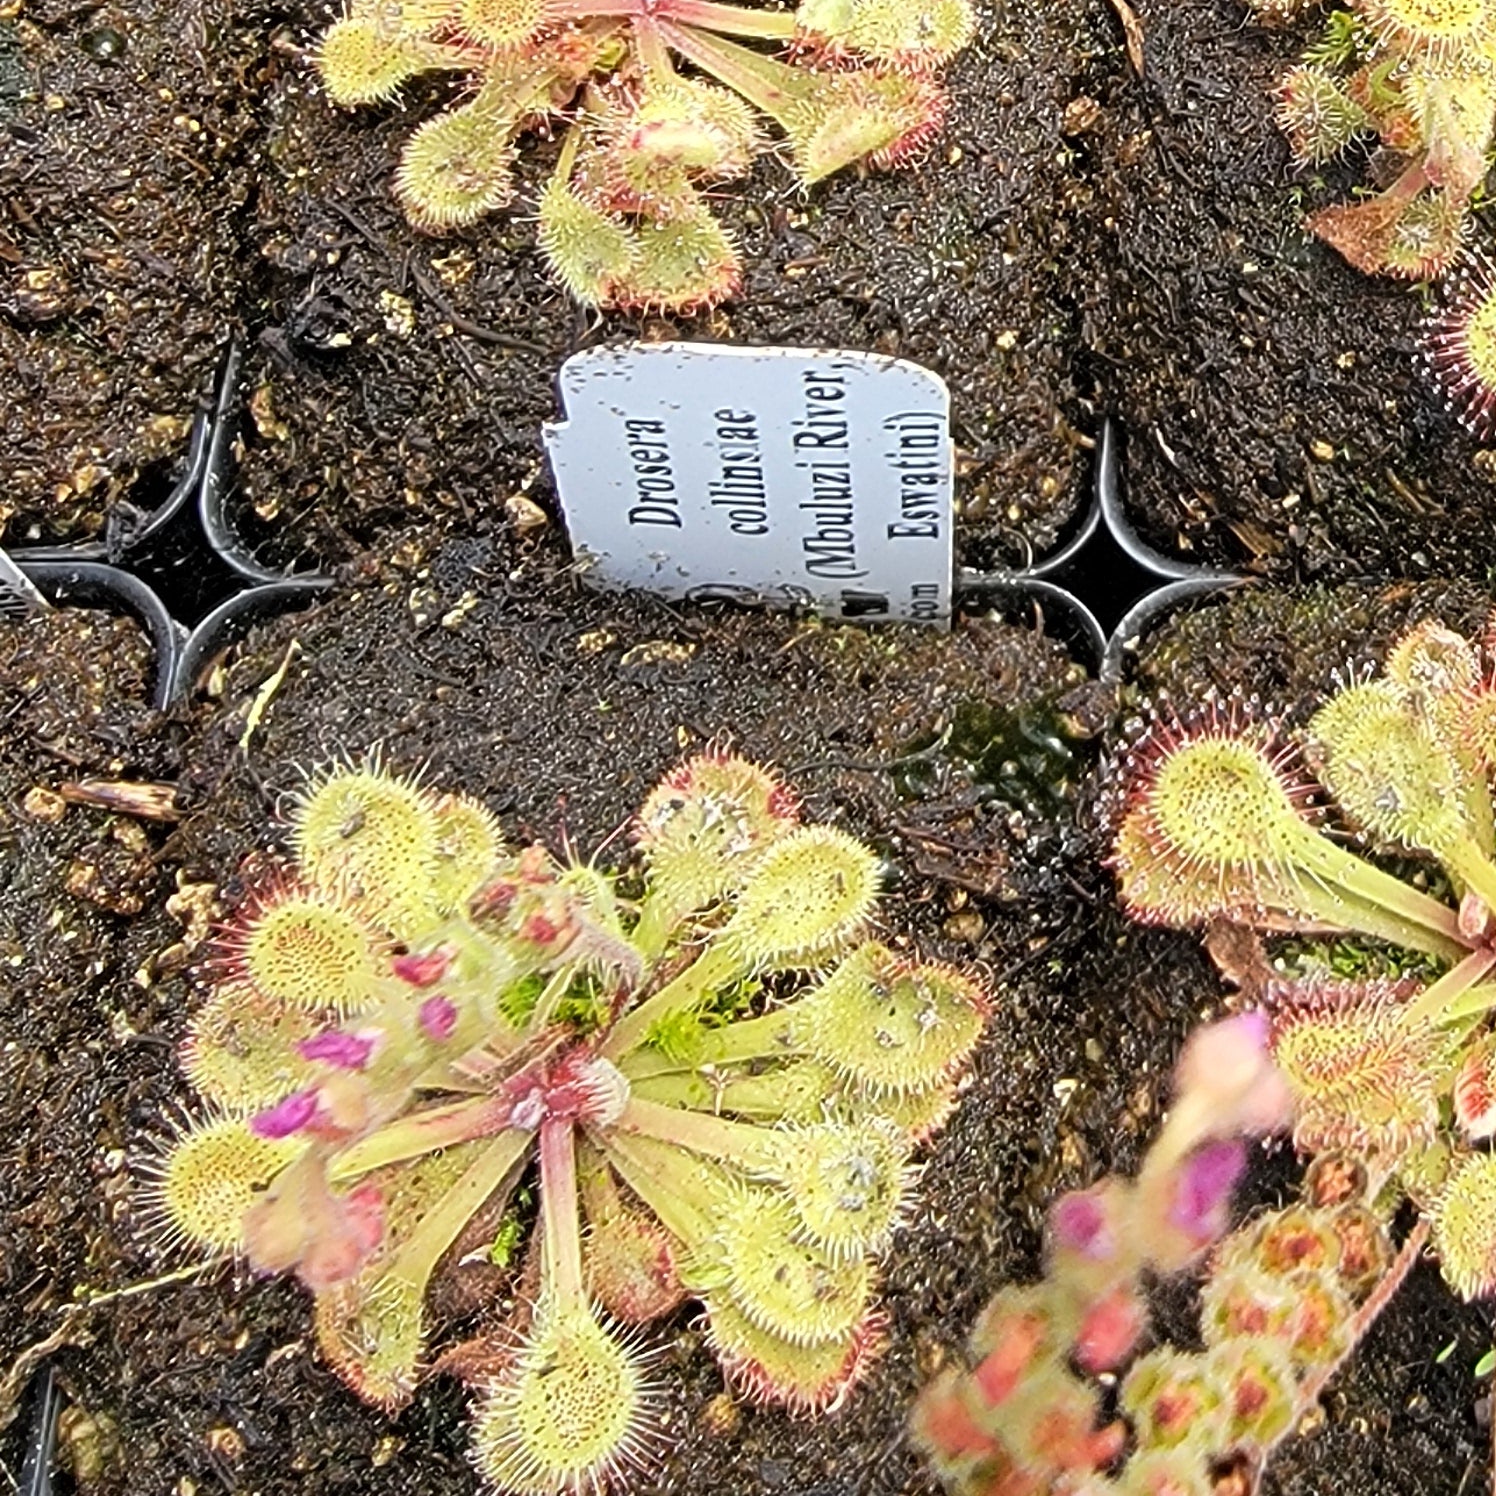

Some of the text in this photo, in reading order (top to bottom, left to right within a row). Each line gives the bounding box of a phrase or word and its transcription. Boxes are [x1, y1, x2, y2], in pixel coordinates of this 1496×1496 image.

[625, 418, 682, 529] Drosera
[792, 361, 869, 578] (Mbuluzi River,
[883, 410, 946, 540] Eswatini)
